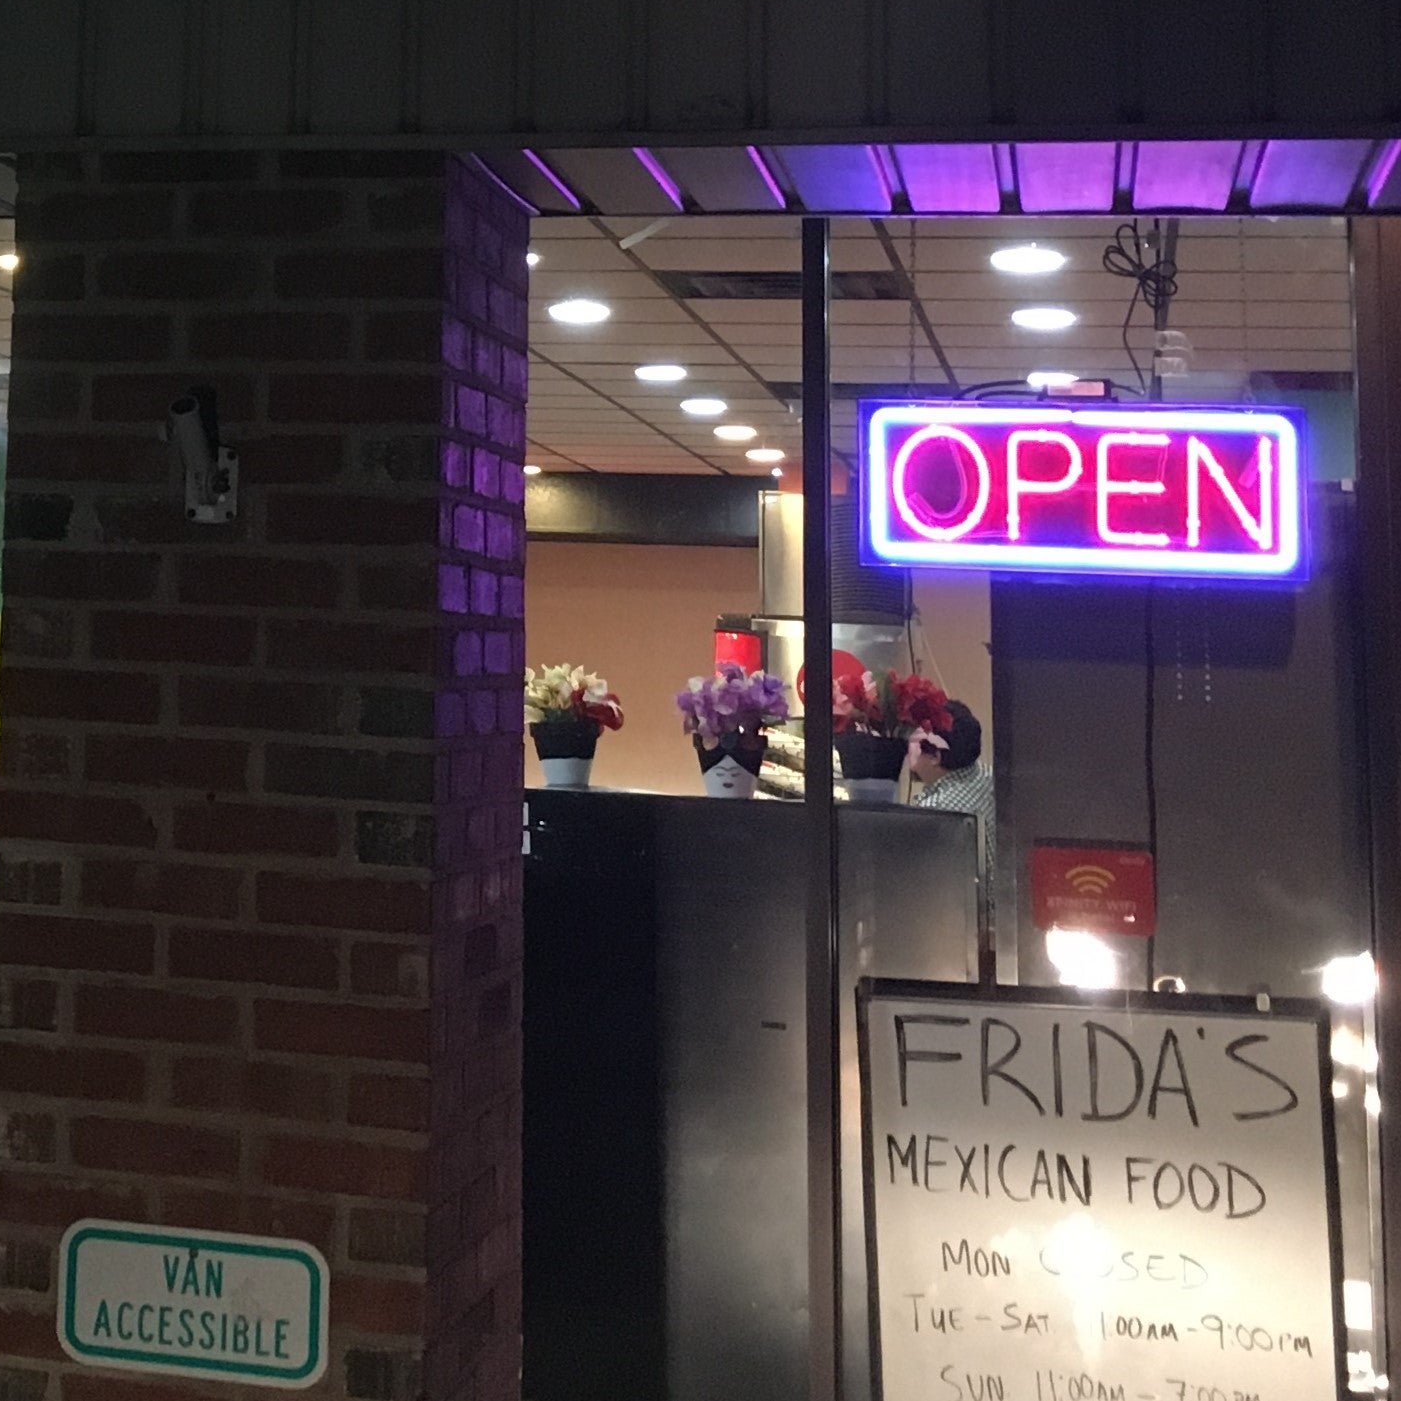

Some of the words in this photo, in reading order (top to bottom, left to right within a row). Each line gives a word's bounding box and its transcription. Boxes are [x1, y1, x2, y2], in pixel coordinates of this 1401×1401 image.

[891, 423, 1275, 551] OPEN
[893, 1013, 1299, 1127] FRIDA'S
[886, 1133, 1093, 1207] MEXICAN
[1125, 1156, 1268, 1219] FOOD
[162, 1254, 224, 1299] VAN
[941, 1238, 1011, 1278] MON
[92, 1299, 291, 1360] ACCESSIBLE
